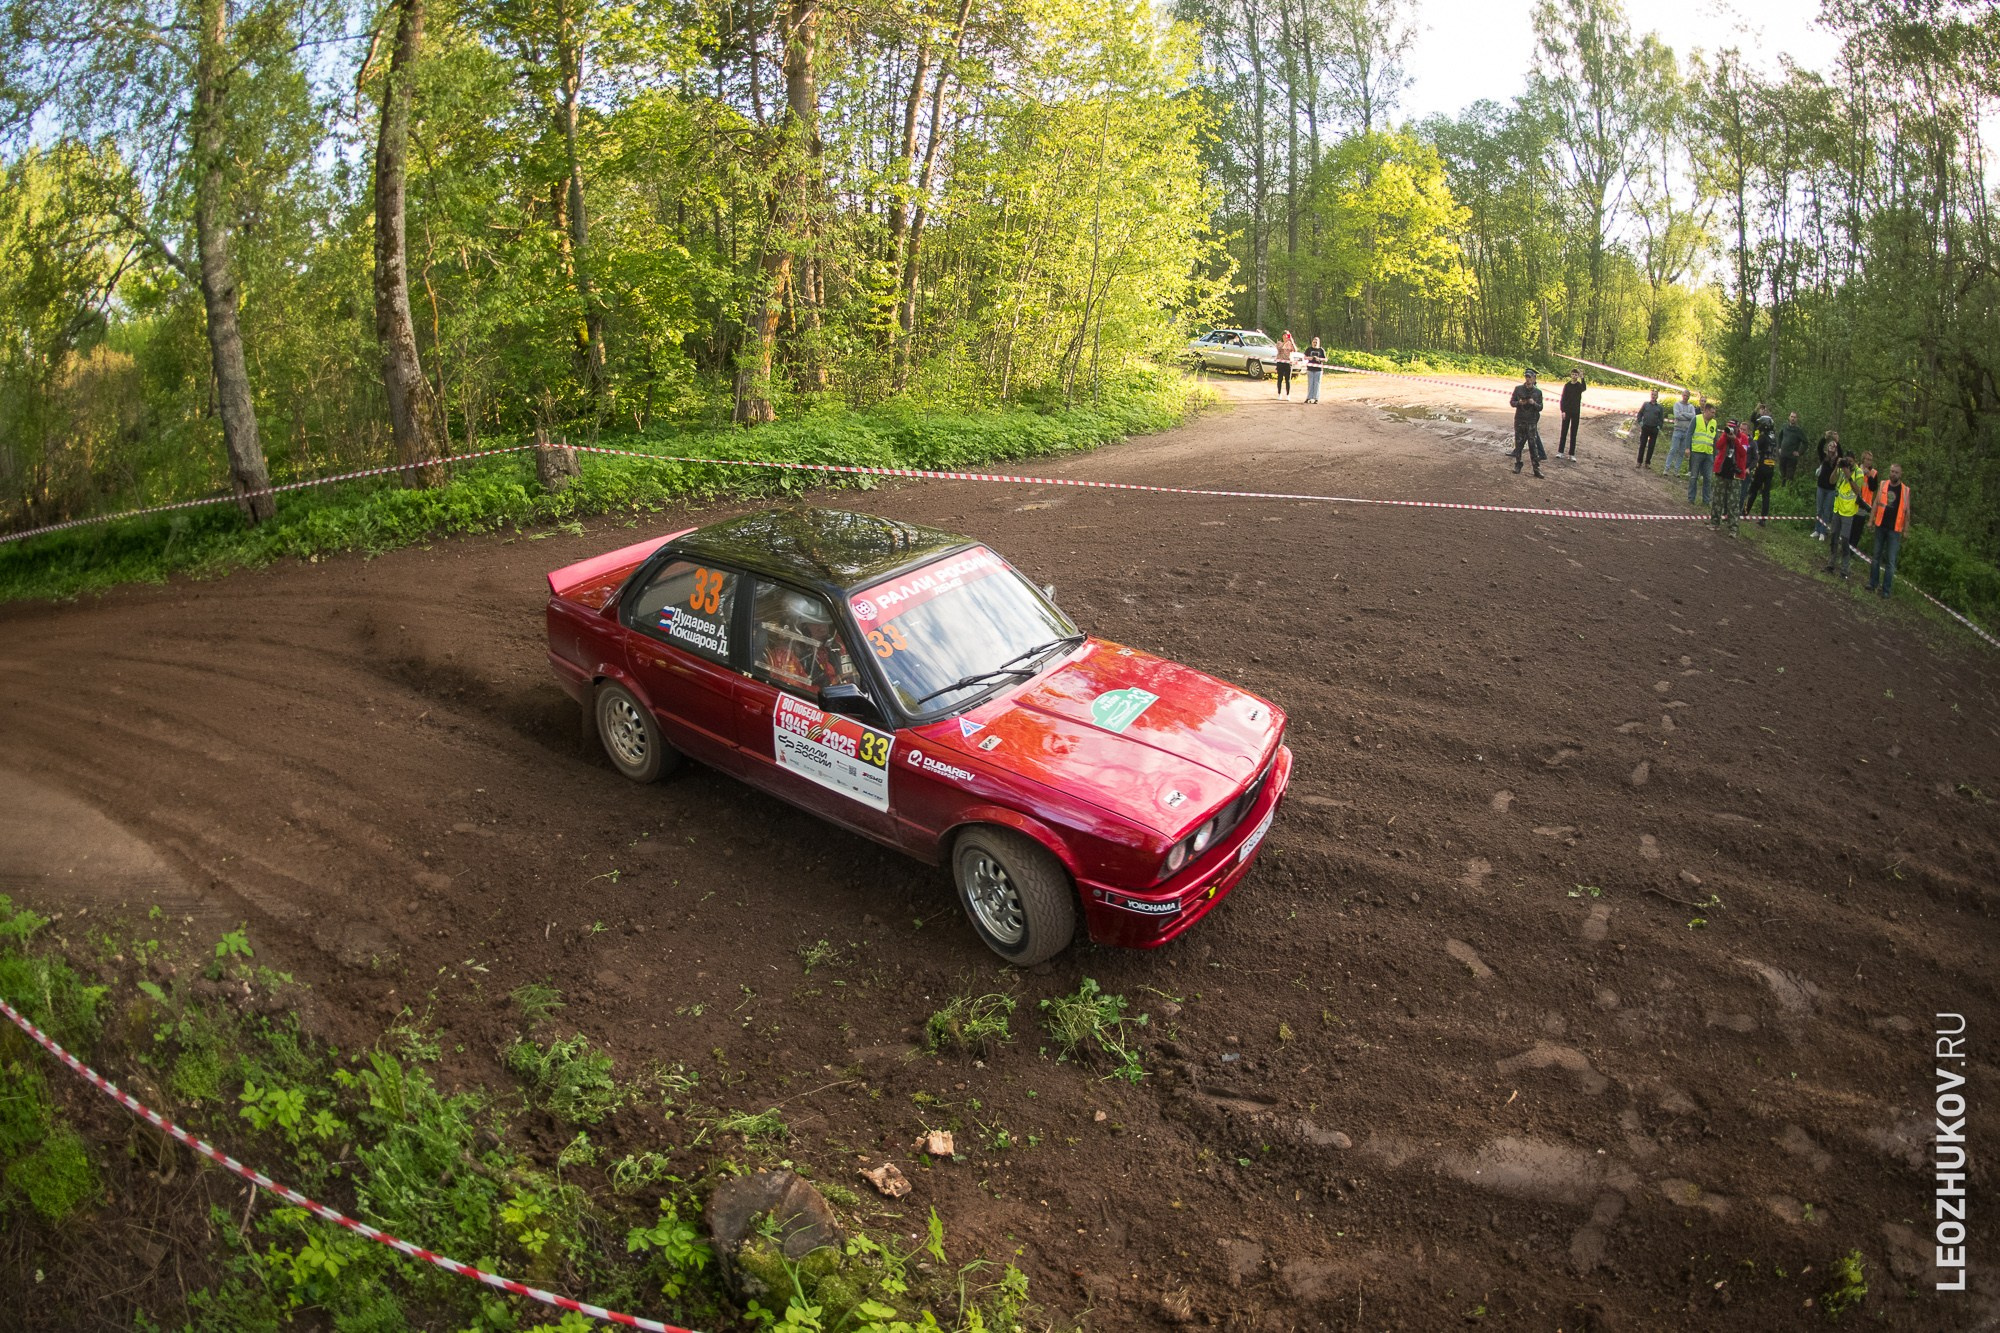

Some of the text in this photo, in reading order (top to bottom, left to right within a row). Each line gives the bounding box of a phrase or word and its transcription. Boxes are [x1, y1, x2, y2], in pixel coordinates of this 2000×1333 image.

[690, 567, 723, 615] 33
[875, 574, 937, 609] РАЛЛИ
[672, 607, 716, 635] Дударев
[669, 621, 718, 651] Кокшаров
[867, 624, 908, 658] 33
[782, 697, 825, 723] 80 ПОБЕДА!
[1127, 689, 1155, 704] 33
[780, 711, 857, 758] 1945 2025
[794, 748, 832, 768] РОССИИ
[795, 740, 828, 759] РАЛЛИ
[860, 732, 889, 767] 33
[922, 764, 960, 781] MOTORSPORT
[923, 757, 976, 781] DUDAREV
[1127, 899, 1176, 911] YOKOHAMA
